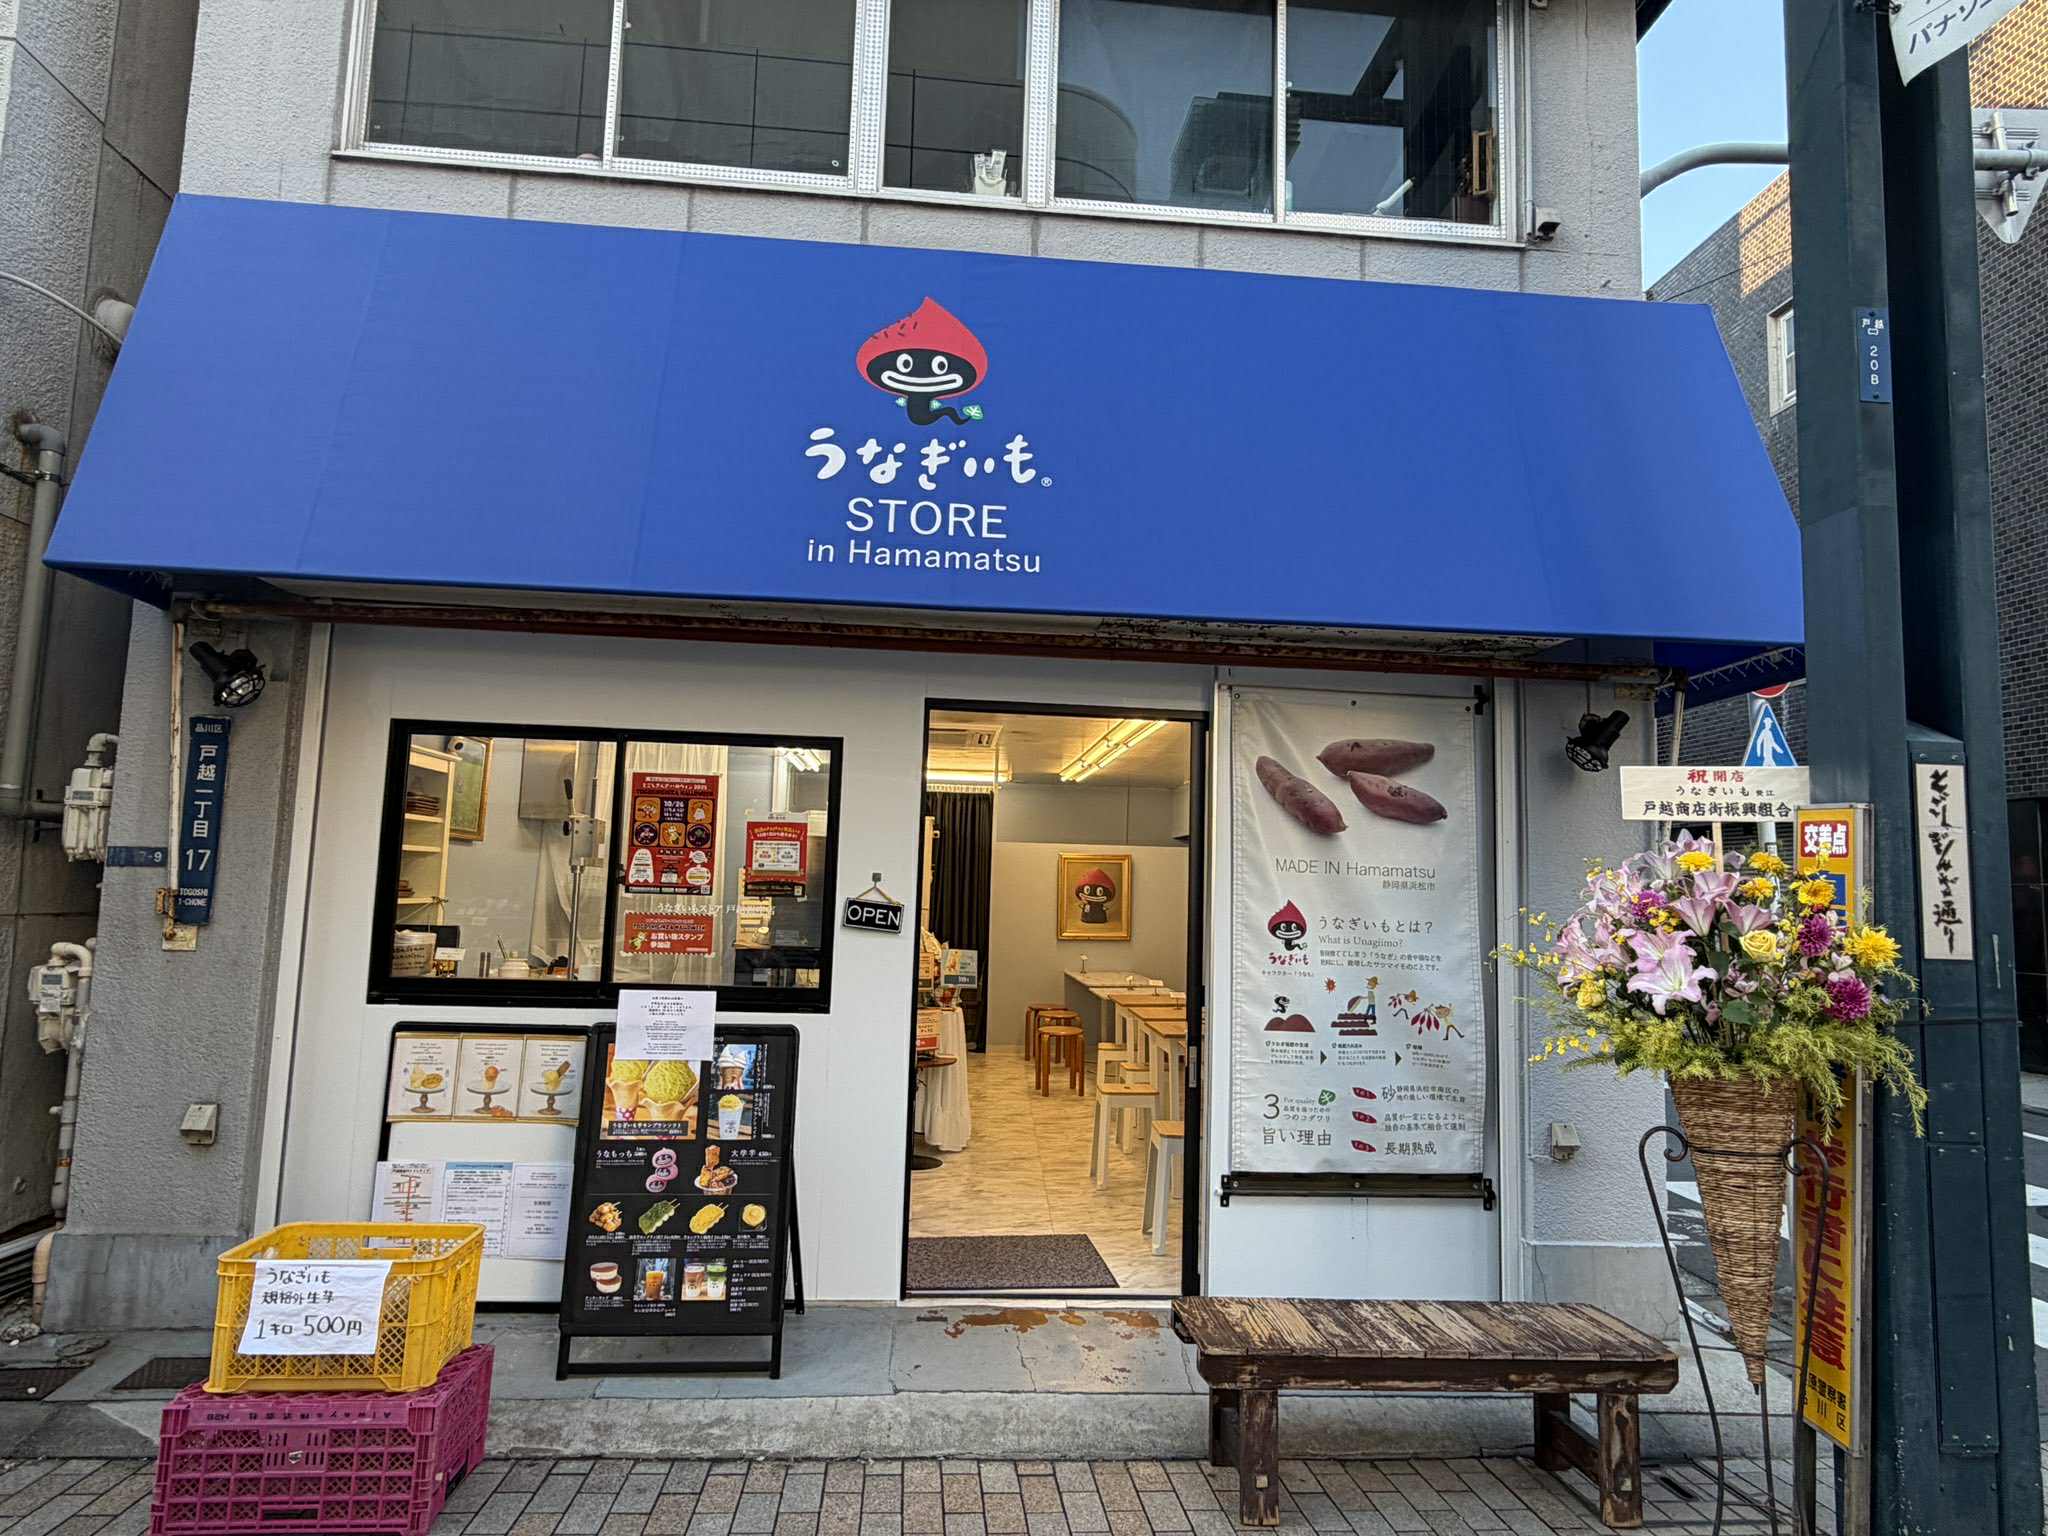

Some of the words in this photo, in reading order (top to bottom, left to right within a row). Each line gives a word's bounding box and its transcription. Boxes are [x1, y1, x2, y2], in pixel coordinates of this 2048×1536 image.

[1909, 0, 1994, 54] パナソ
[805, 427, 1037, 491] うなぎいも
[846, 497, 1008, 540] STORE
[807, 539, 835, 562] in
[848, 539, 1041, 573] Hamamatsu
[195, 723, 224, 734] 品川区
[192, 745, 218, 838] 戸越一丁目
[1642, 800, 1792, 818] 戸越商店街振興組合
[1804, 823, 1848, 855] 交差点
[185, 849, 211, 871] 17
[1275, 858, 1319, 875] MADE
[1324, 860, 1341, 875] IN
[1346, 861, 1436, 879] Hamamatsu
[180, 888, 208, 896] TOGOSHI
[1382, 880, 1436, 891] 静岡県浜松市
[847, 904, 900, 926] OPEN
[1318, 935, 1342, 945] What
[1343, 936, 1351, 945] is
[1353, 936, 1403, 949] Unagiimo?
[1263, 1094, 1280, 1119] 3
[1263, 1126, 1332, 1146] 旨い理由
[1384, 1142, 1438, 1156] 長期熟成
[265, 1265, 331, 1285] うなぎいも
[303, 1314, 362, 1337] 500円
